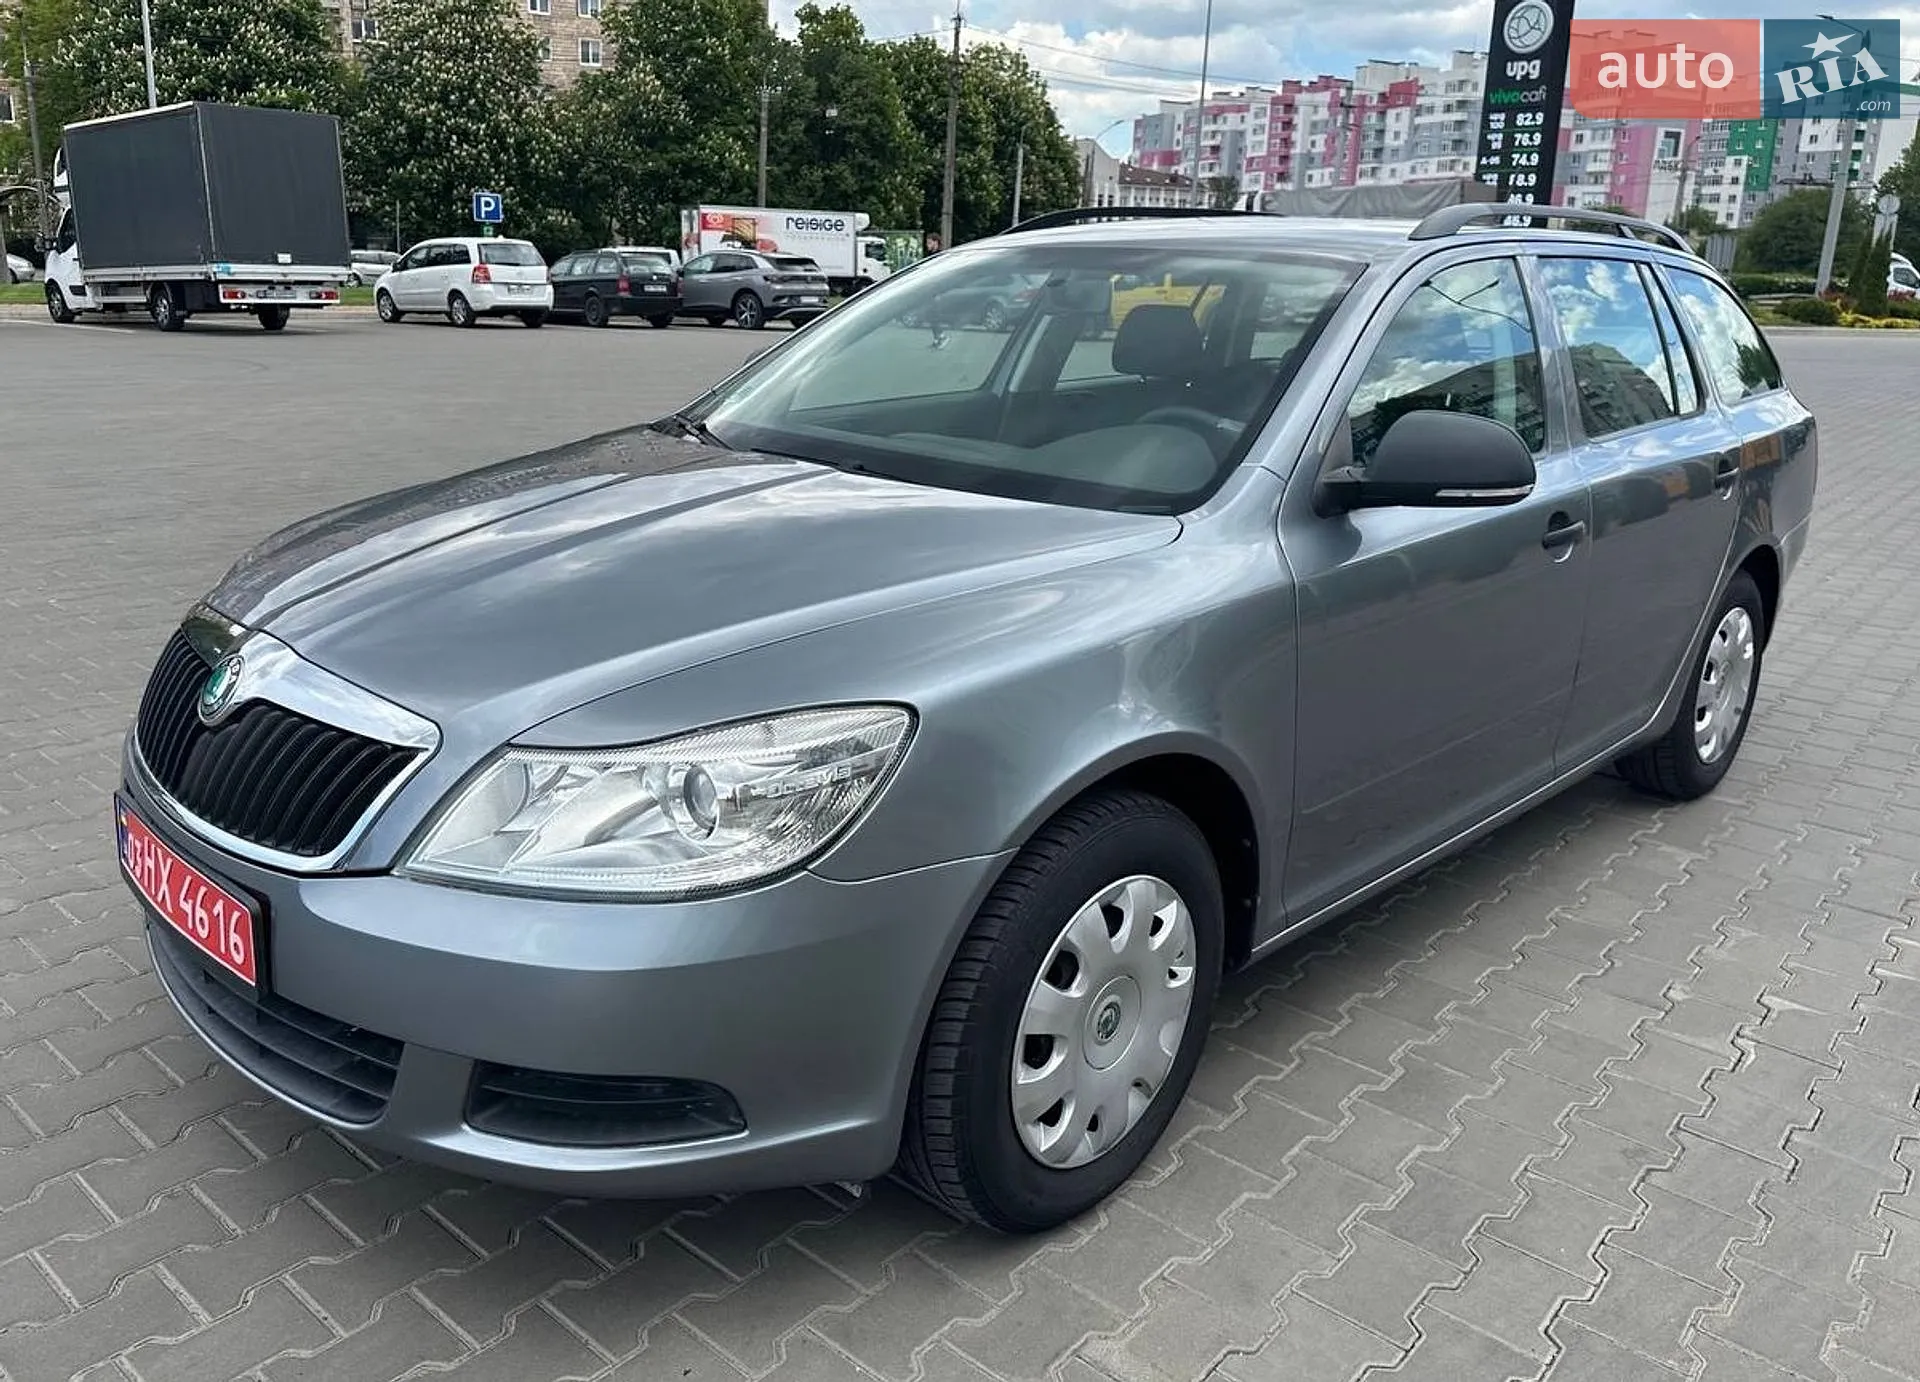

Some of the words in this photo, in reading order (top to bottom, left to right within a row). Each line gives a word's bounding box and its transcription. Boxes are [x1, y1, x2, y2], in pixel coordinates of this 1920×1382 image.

[1506, 59, 1541, 81] upg
[1516, 112, 1544, 126] 82.9
[1514, 132, 1542, 146] 76.9
[1511, 153, 1539, 167] 74.9
[481, 196, 496, 218] P
[179, 875, 246, 966] 4616
